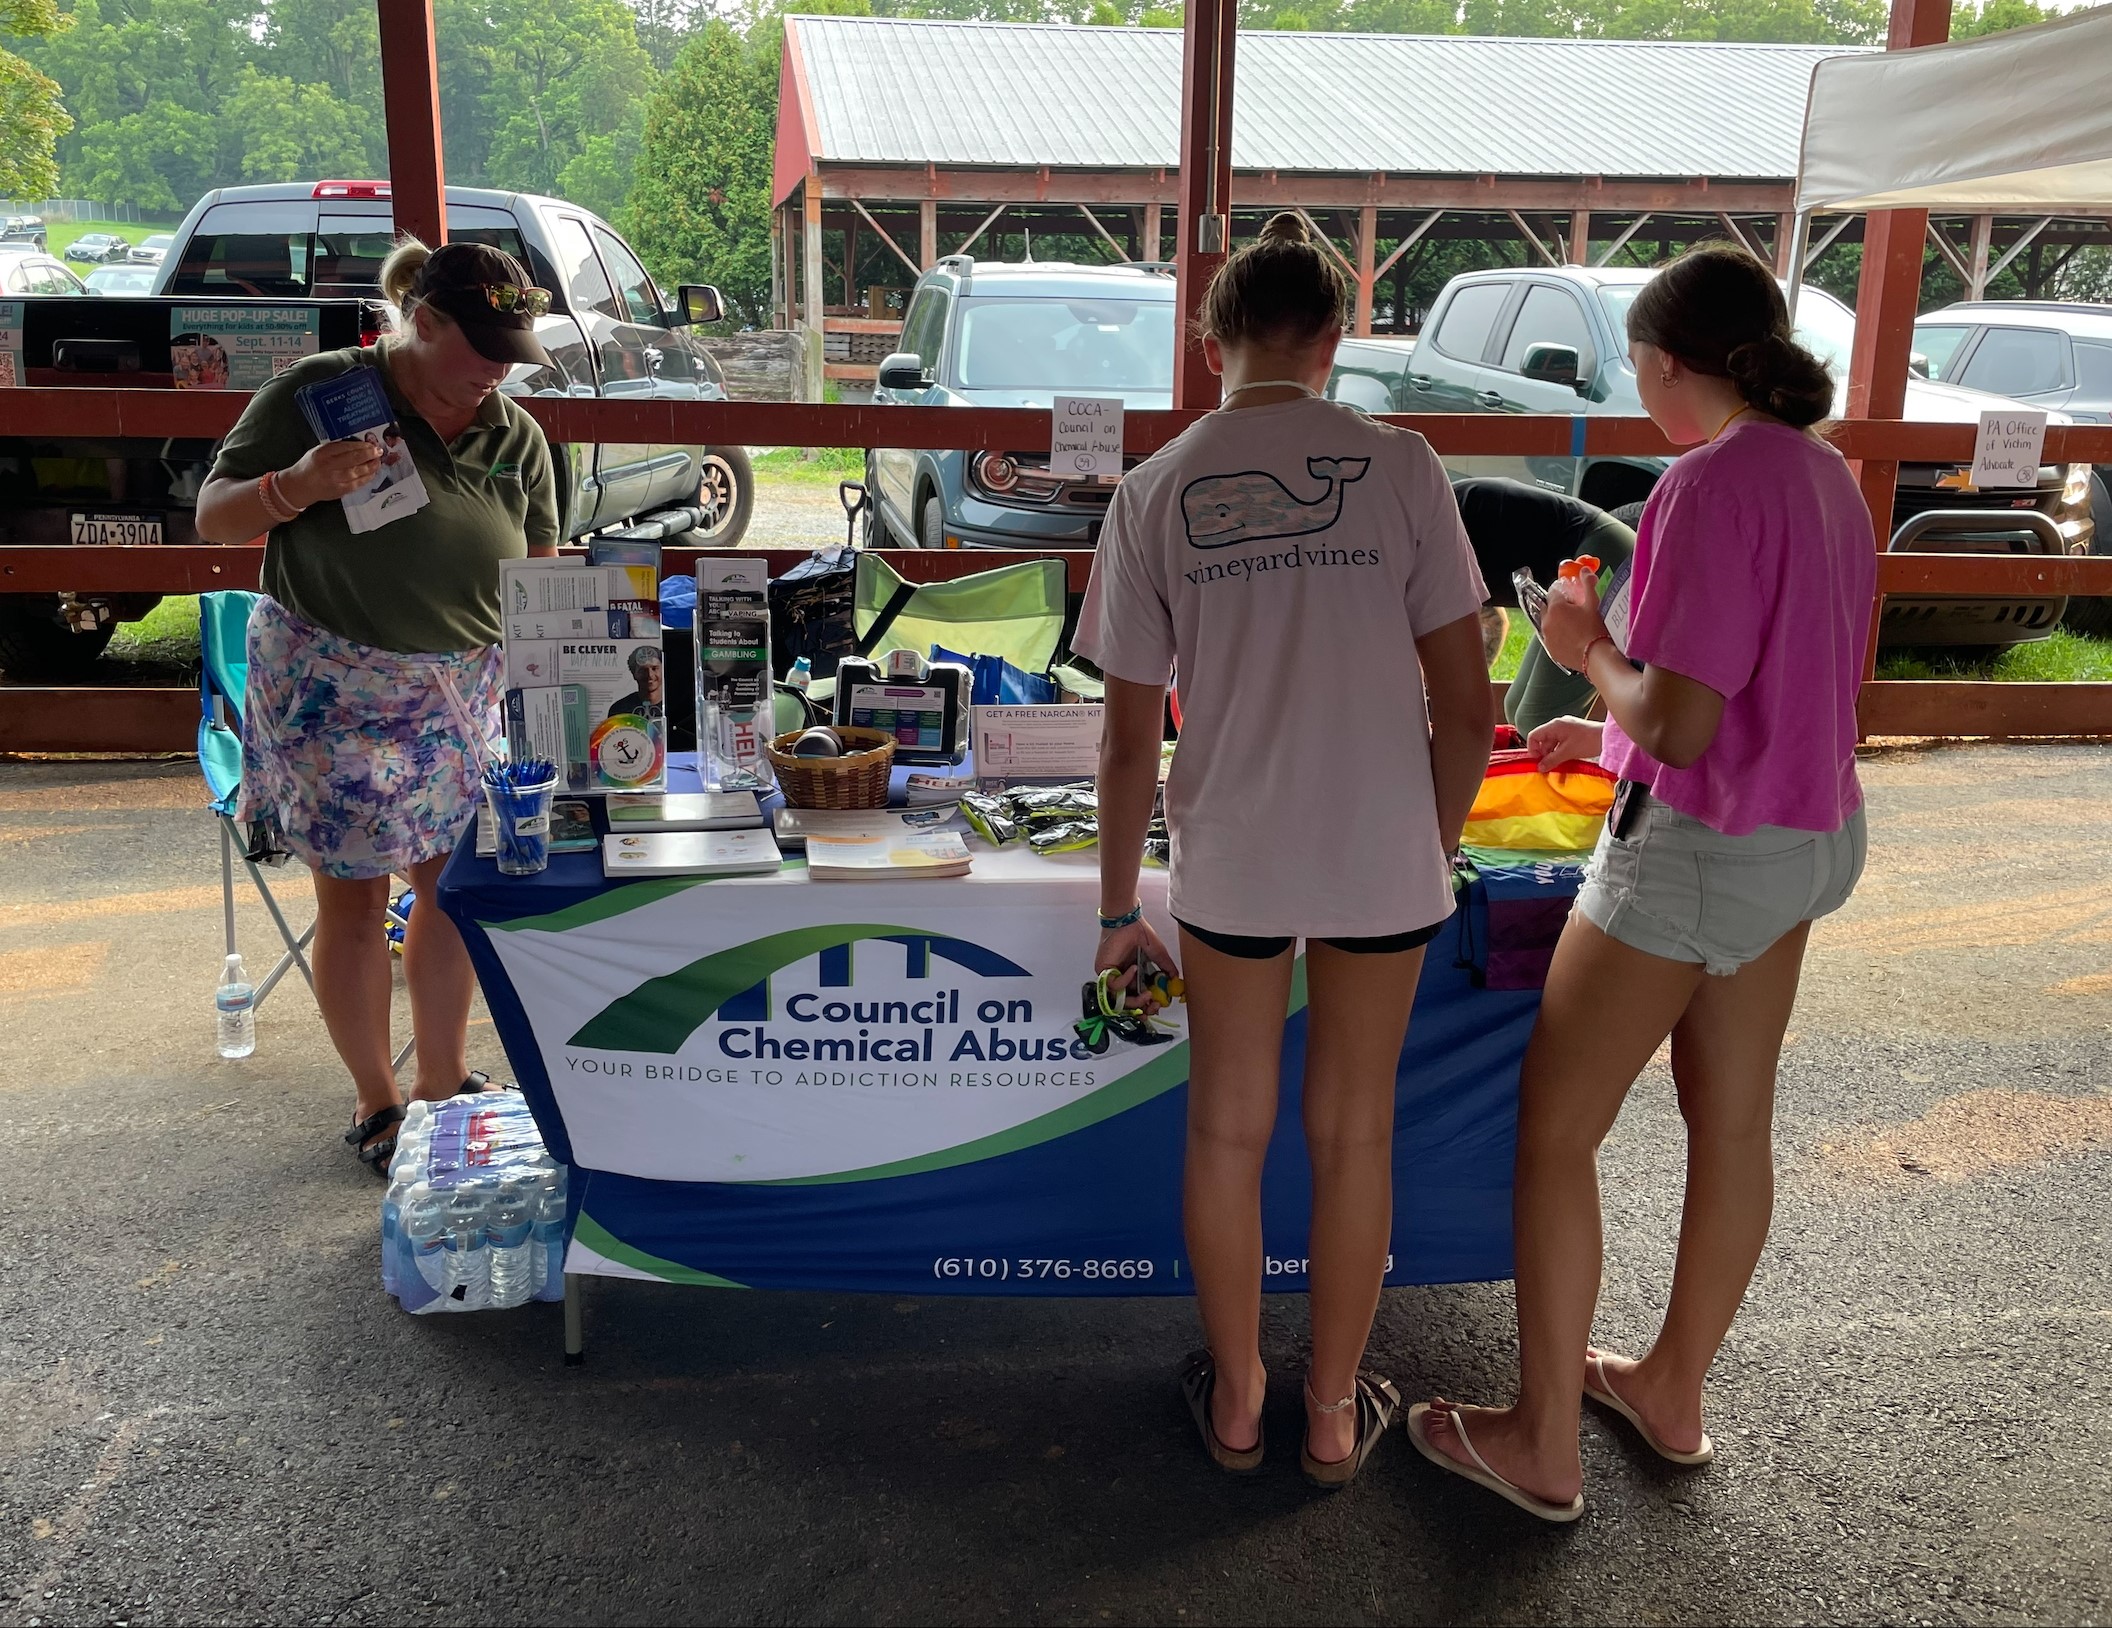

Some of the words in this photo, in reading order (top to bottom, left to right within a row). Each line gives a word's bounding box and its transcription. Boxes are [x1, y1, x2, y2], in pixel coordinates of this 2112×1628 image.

[182, 310, 219, 322] HUGE
[221, 310, 271, 322] POP-UP
[272, 310, 308, 323] SALE!
[182, 323, 224, 331] Everything
[236, 336, 266, 349] Sept.
[272, 337, 301, 347] 11-14
[326, 394, 345, 405] BERKS
[347, 383, 371, 396] COUNTY
[344, 397, 375, 413] ALCOHOL
[1068, 401, 1109, 416] COCA-
[337, 402, 378, 423] TREATMENT
[1059, 421, 1093, 434] Council
[1104, 424, 1116, 434] on
[1986, 420, 2000, 436] PA
[2006, 420, 2038, 436] Office
[1055, 441, 1087, 453] Chemical
[1092, 440, 1121, 453] Abuse
[1986, 440, 1995, 451] of
[2003, 439, 2032, 450] Victim
[1979, 457, 2016, 472] Advocate
[1184, 544, 1301, 585] vineyard
[1305, 543, 1379, 565] vines
[618, 602, 643, 611] FATAL
[513, 624, 522, 638] KIT
[536, 624, 544, 638] KIT
[709, 630, 733, 638] Talking
[563, 645, 576, 654] BE
[578, 645, 617, 654] CLEVER
[711, 651, 757, 659] GAMBLING
[986, 710, 1002, 718] GET
[1006, 710, 1012, 718] A
[1016, 710, 1037, 718] FREE
[1088, 709, 1102, 717] KIT
[1534, 862, 1555, 885] YOU
[786, 989, 960, 1025] Council
[978, 997, 1033, 1023] on
[718, 1025, 932, 1063] Chemical
[949, 1027, 1093, 1062] Abuse
[565, 1056, 633, 1079] YOUR
[645, 1065, 738, 1084] BRIDGE
[750, 1070, 783, 1086] TO
[795, 1071, 937, 1088] ADDICTION
[950, 1071, 1096, 1087] RESOURCES
[933, 1257, 1009, 1279] (610)
[1017, 1259, 1154, 1279] 376-8669
